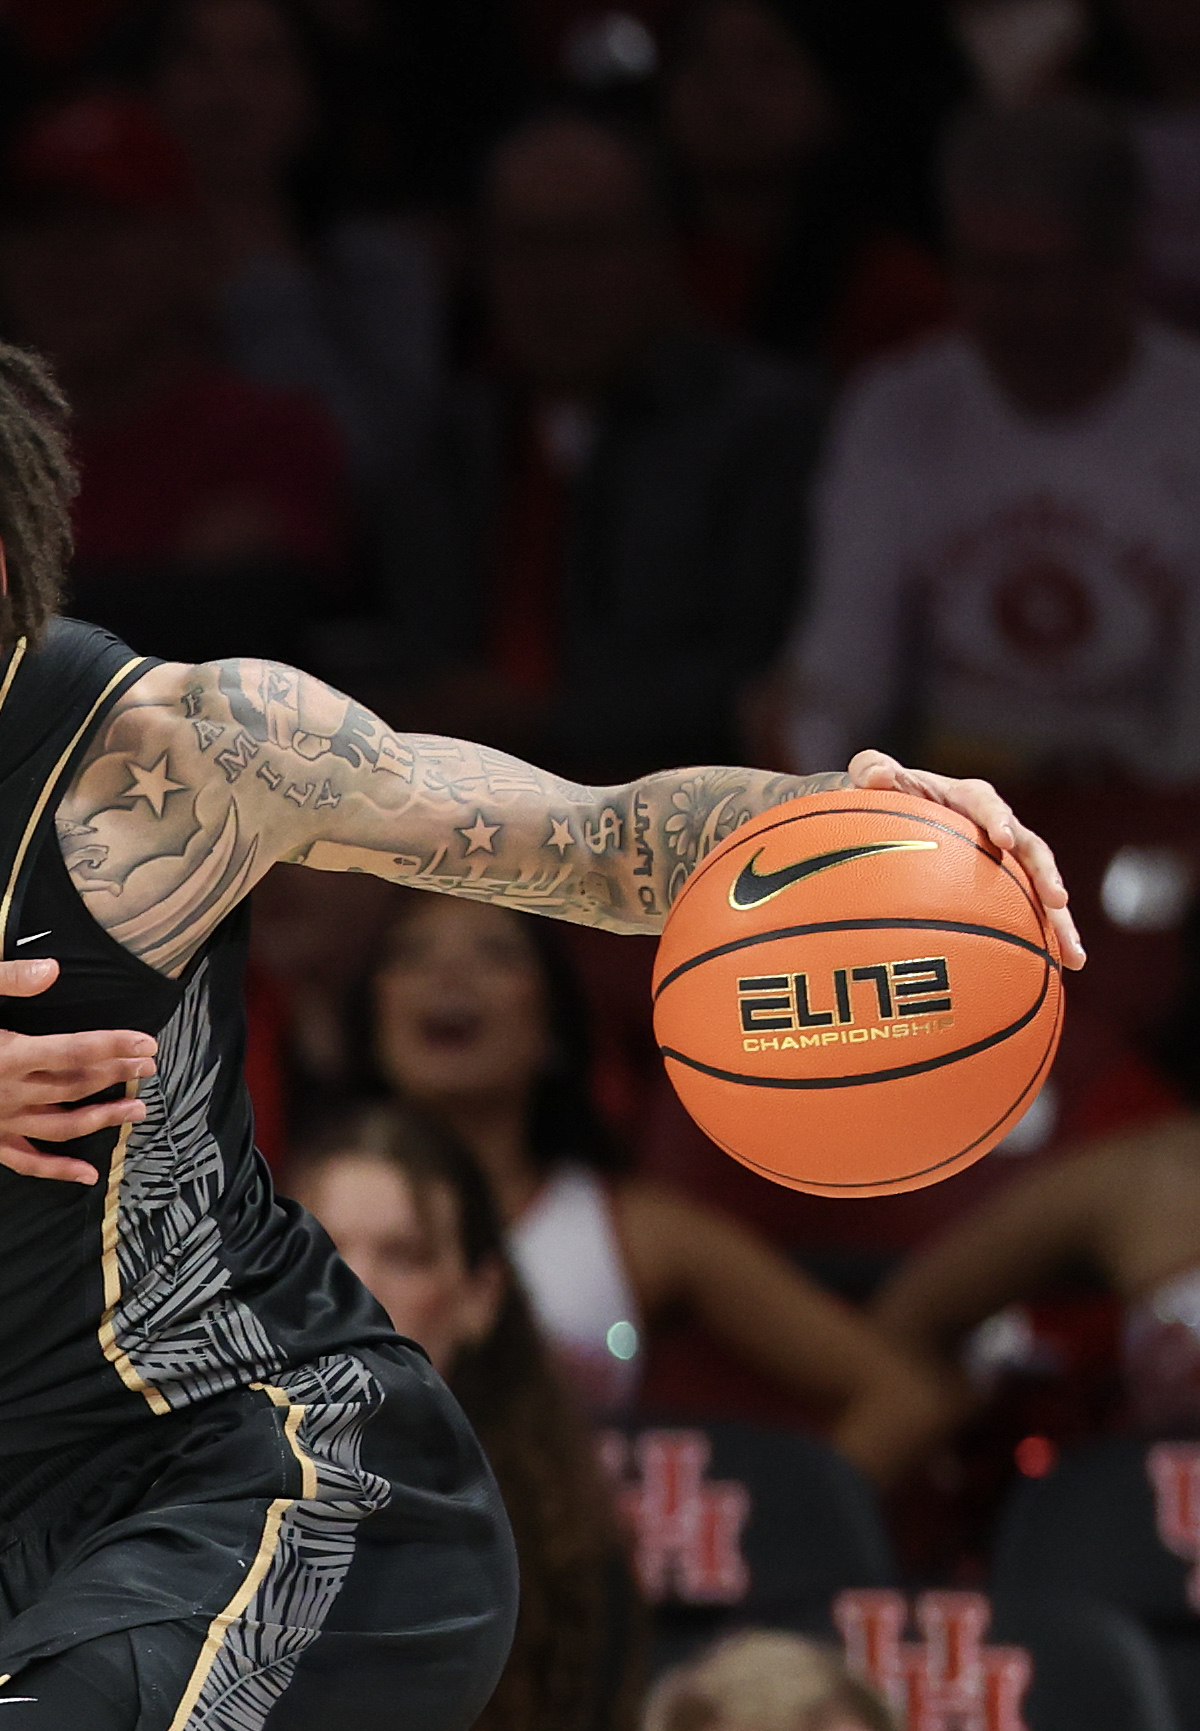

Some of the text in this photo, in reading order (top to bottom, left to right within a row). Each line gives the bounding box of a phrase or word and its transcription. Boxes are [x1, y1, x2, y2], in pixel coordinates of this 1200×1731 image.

[180, 688, 342, 810] FAMILY
[736, 955, 953, 1034] ELITE
[742, 1018, 954, 1053] CHAMPIONSHIP
